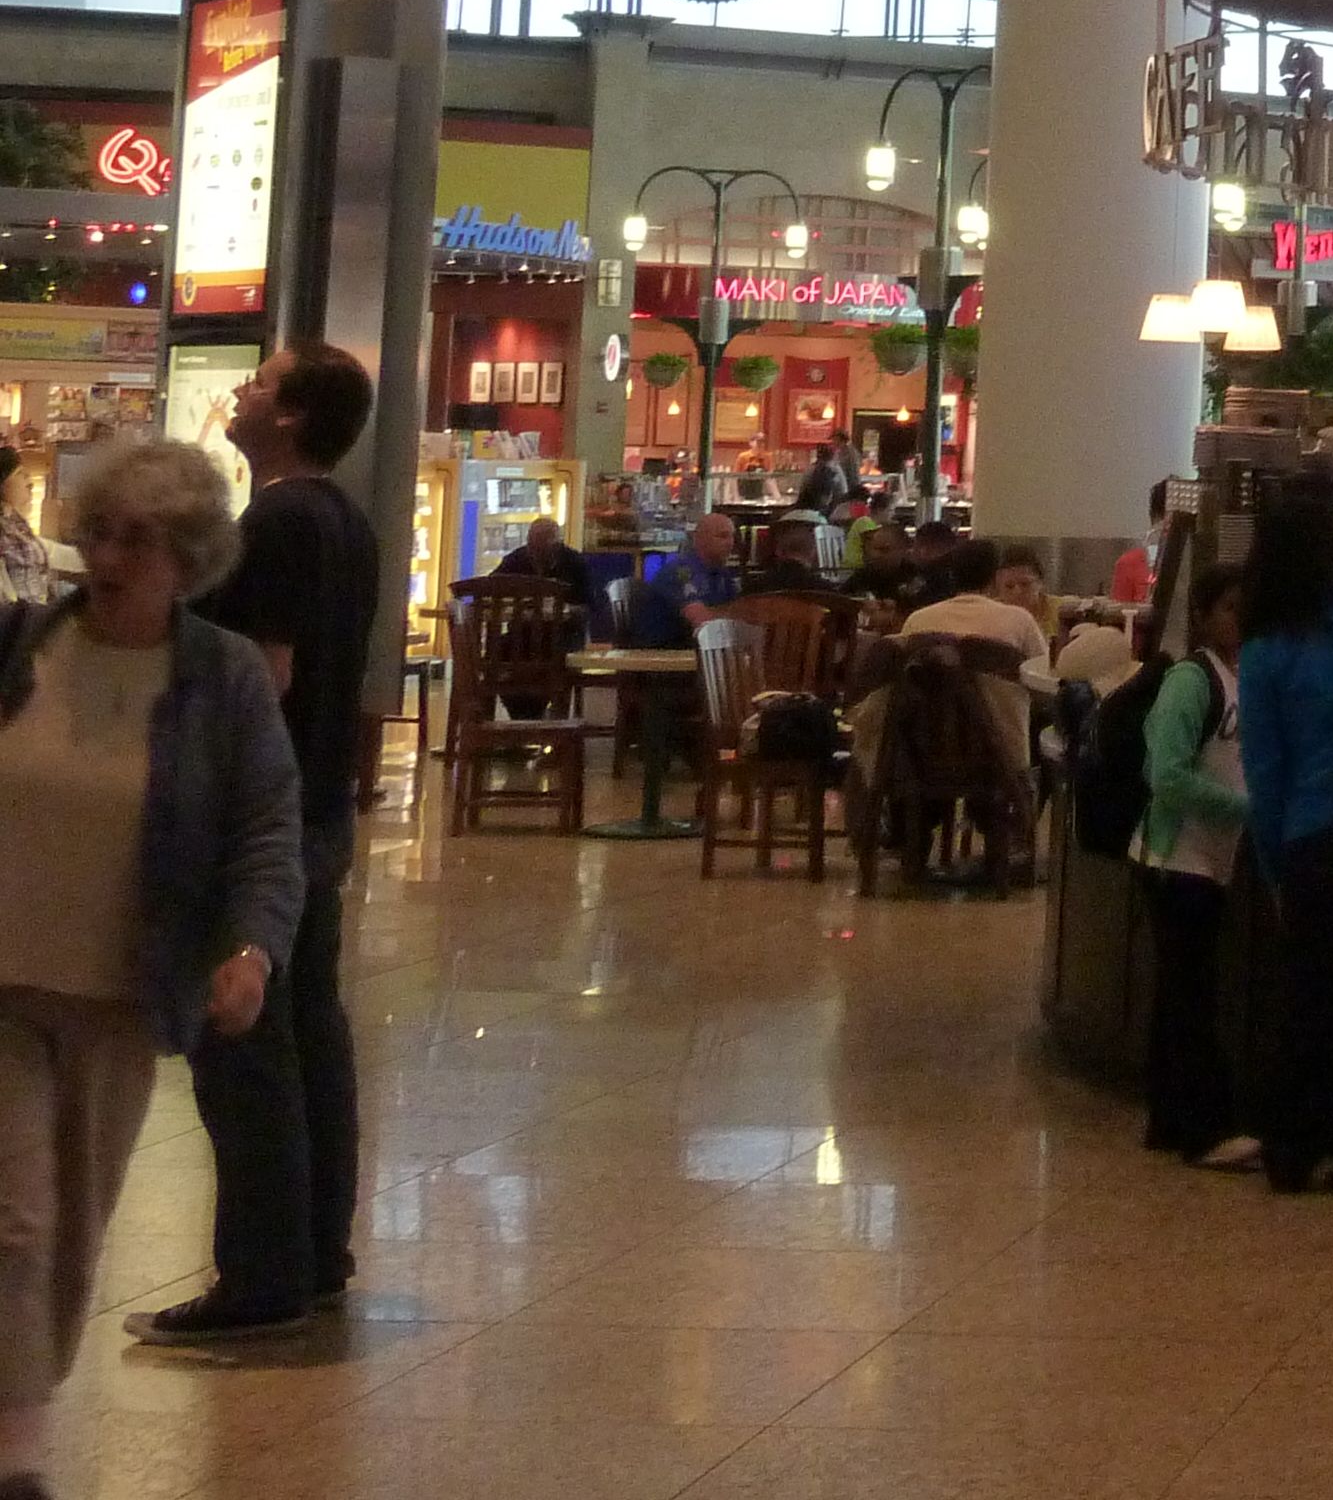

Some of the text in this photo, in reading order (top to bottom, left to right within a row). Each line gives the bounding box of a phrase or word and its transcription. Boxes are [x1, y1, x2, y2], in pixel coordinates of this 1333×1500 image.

[441, 205, 558, 257] Hudson
[714, 276, 910, 306] MAKI of JAPAN
